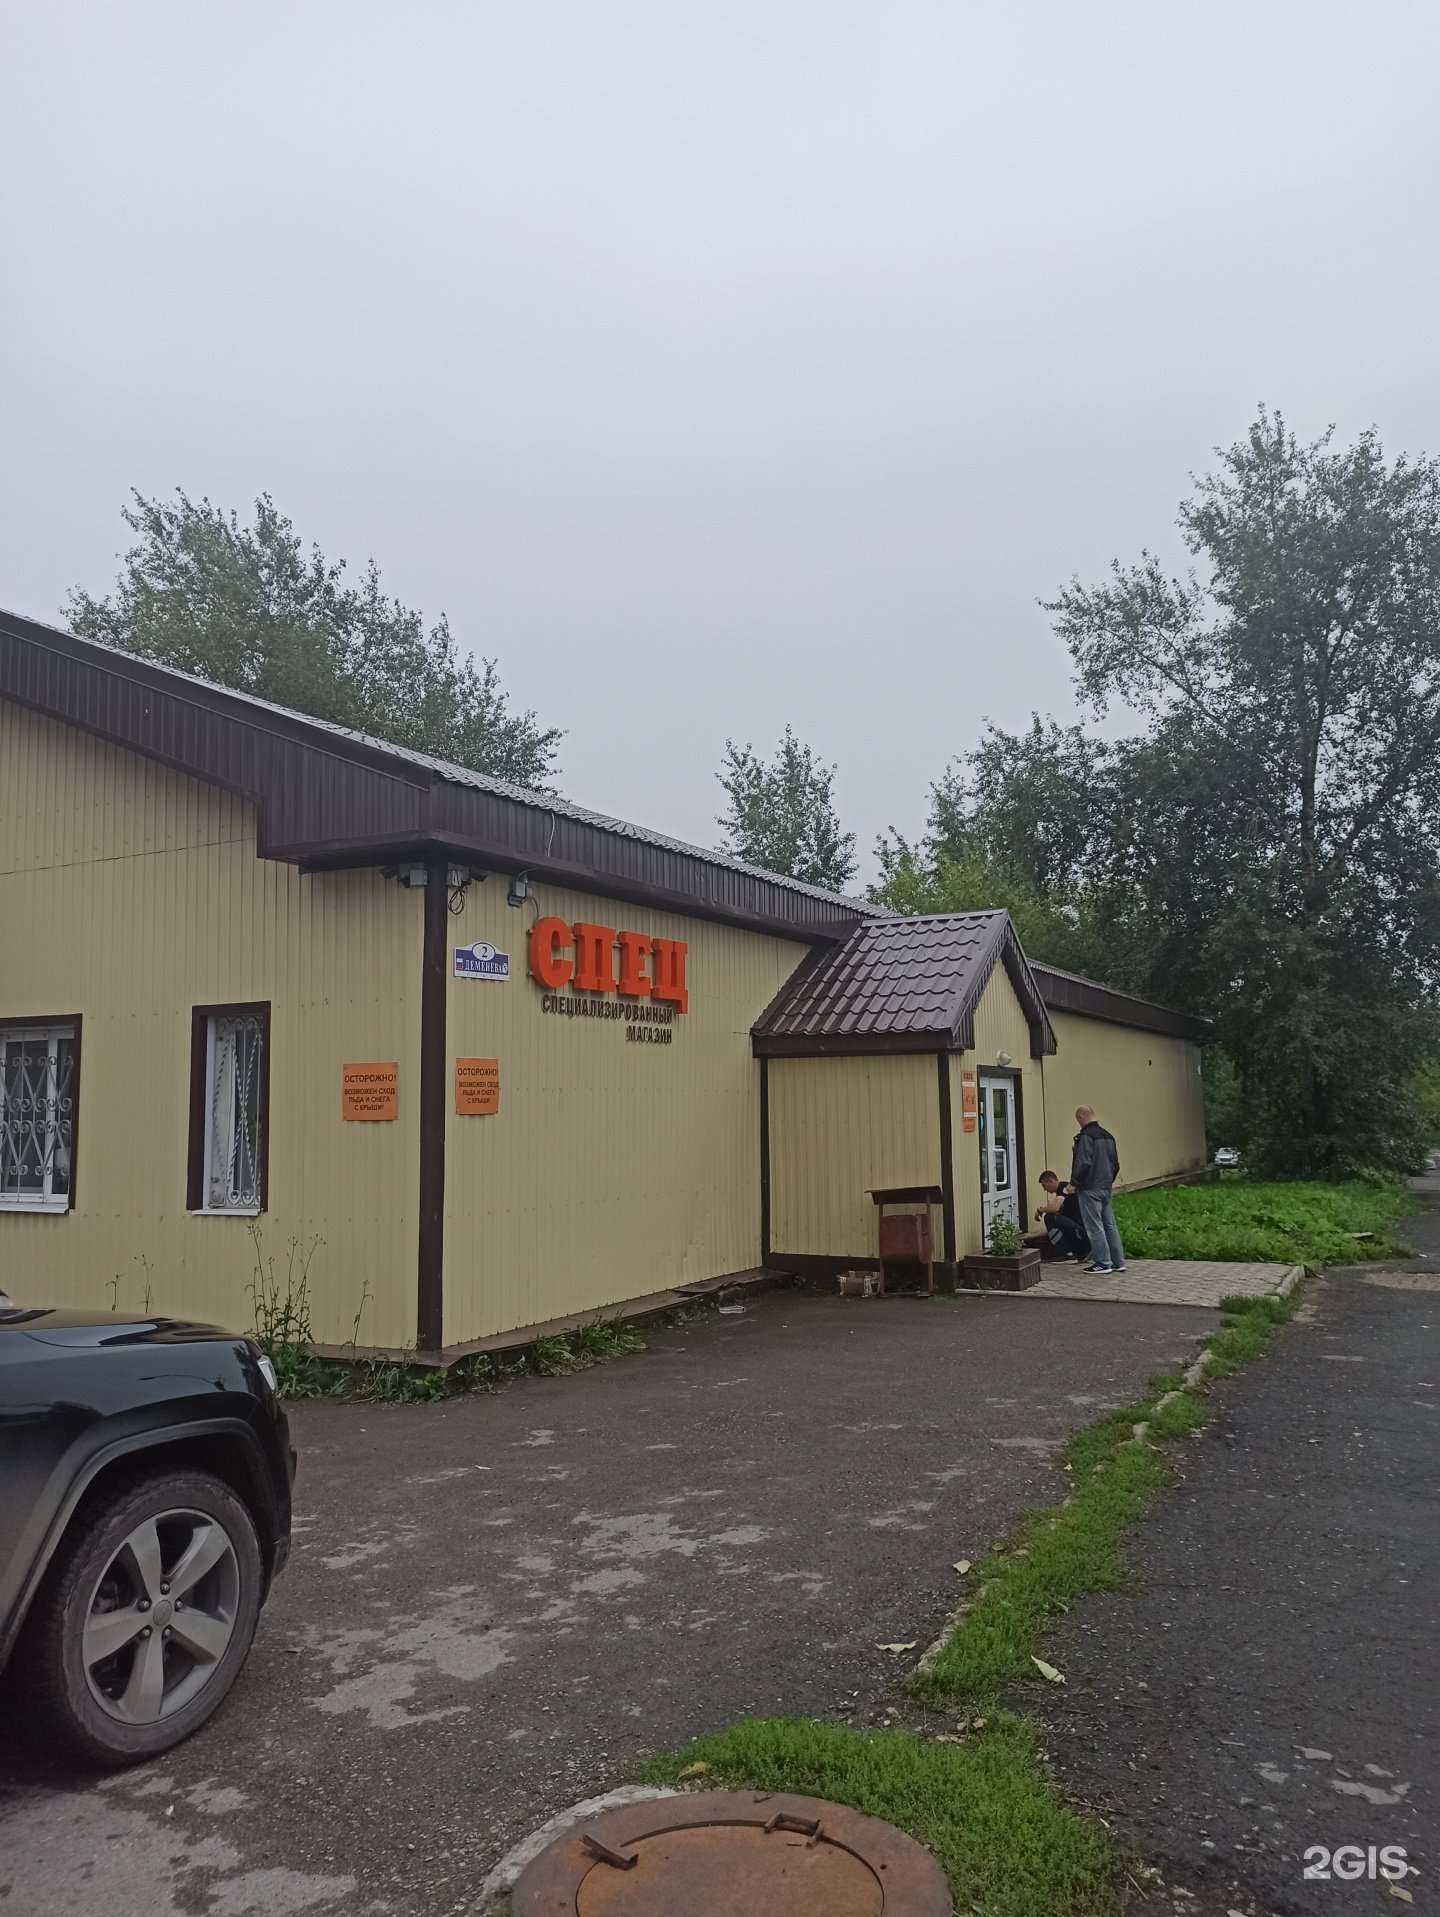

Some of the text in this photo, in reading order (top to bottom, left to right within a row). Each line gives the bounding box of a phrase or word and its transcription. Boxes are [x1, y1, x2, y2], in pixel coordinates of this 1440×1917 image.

[481, 946, 488, 958] 2
[465, 960, 503, 973] ДЕМЕНЕВА
[530, 917, 689, 1015] СПЕЦ
[542, 995, 673, 1024] СПЕЦИАЛИЗИРОВАННЫЙ
[627, 1025, 673, 1045] МАГАЗИН
[344, 1073, 396, 1083] ОСТОРОЖНО!
